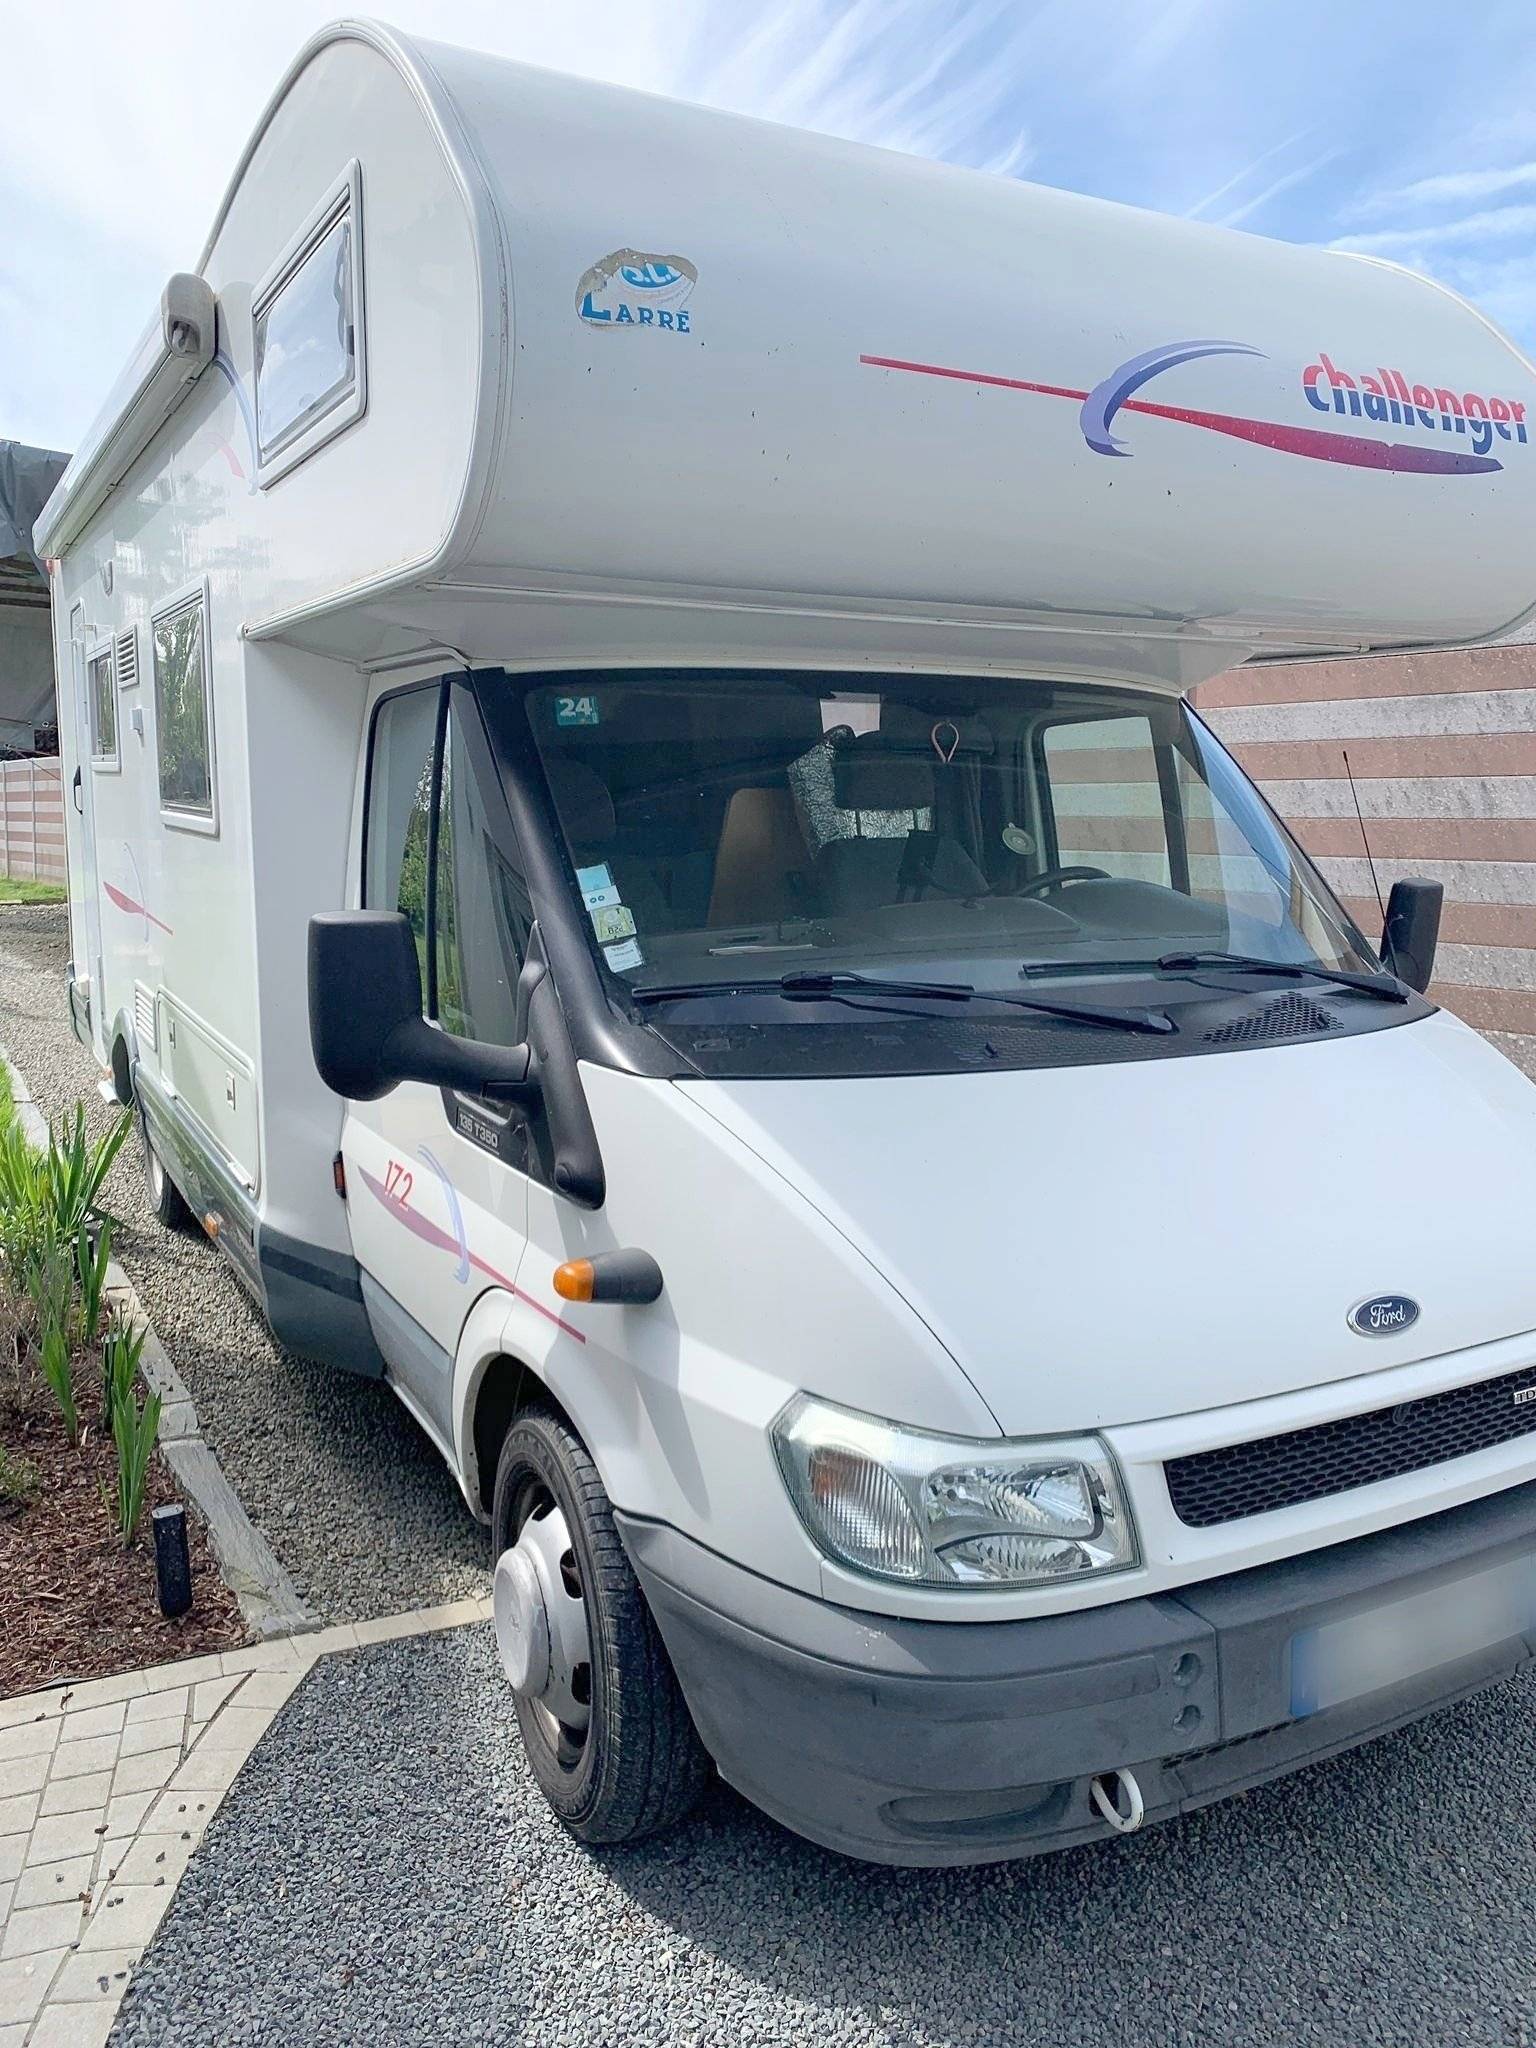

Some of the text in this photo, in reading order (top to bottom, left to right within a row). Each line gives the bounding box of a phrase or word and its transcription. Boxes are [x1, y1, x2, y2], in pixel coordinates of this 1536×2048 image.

[582, 292, 690, 333] LARRÉ
[1303, 352, 1528, 455] challenger
[558, 697, 593, 717] 24
[459, 1113, 499, 1148] 135 T350
[384, 1159, 413, 1211] 172
[1370, 1301, 1406, 1328] Ford
